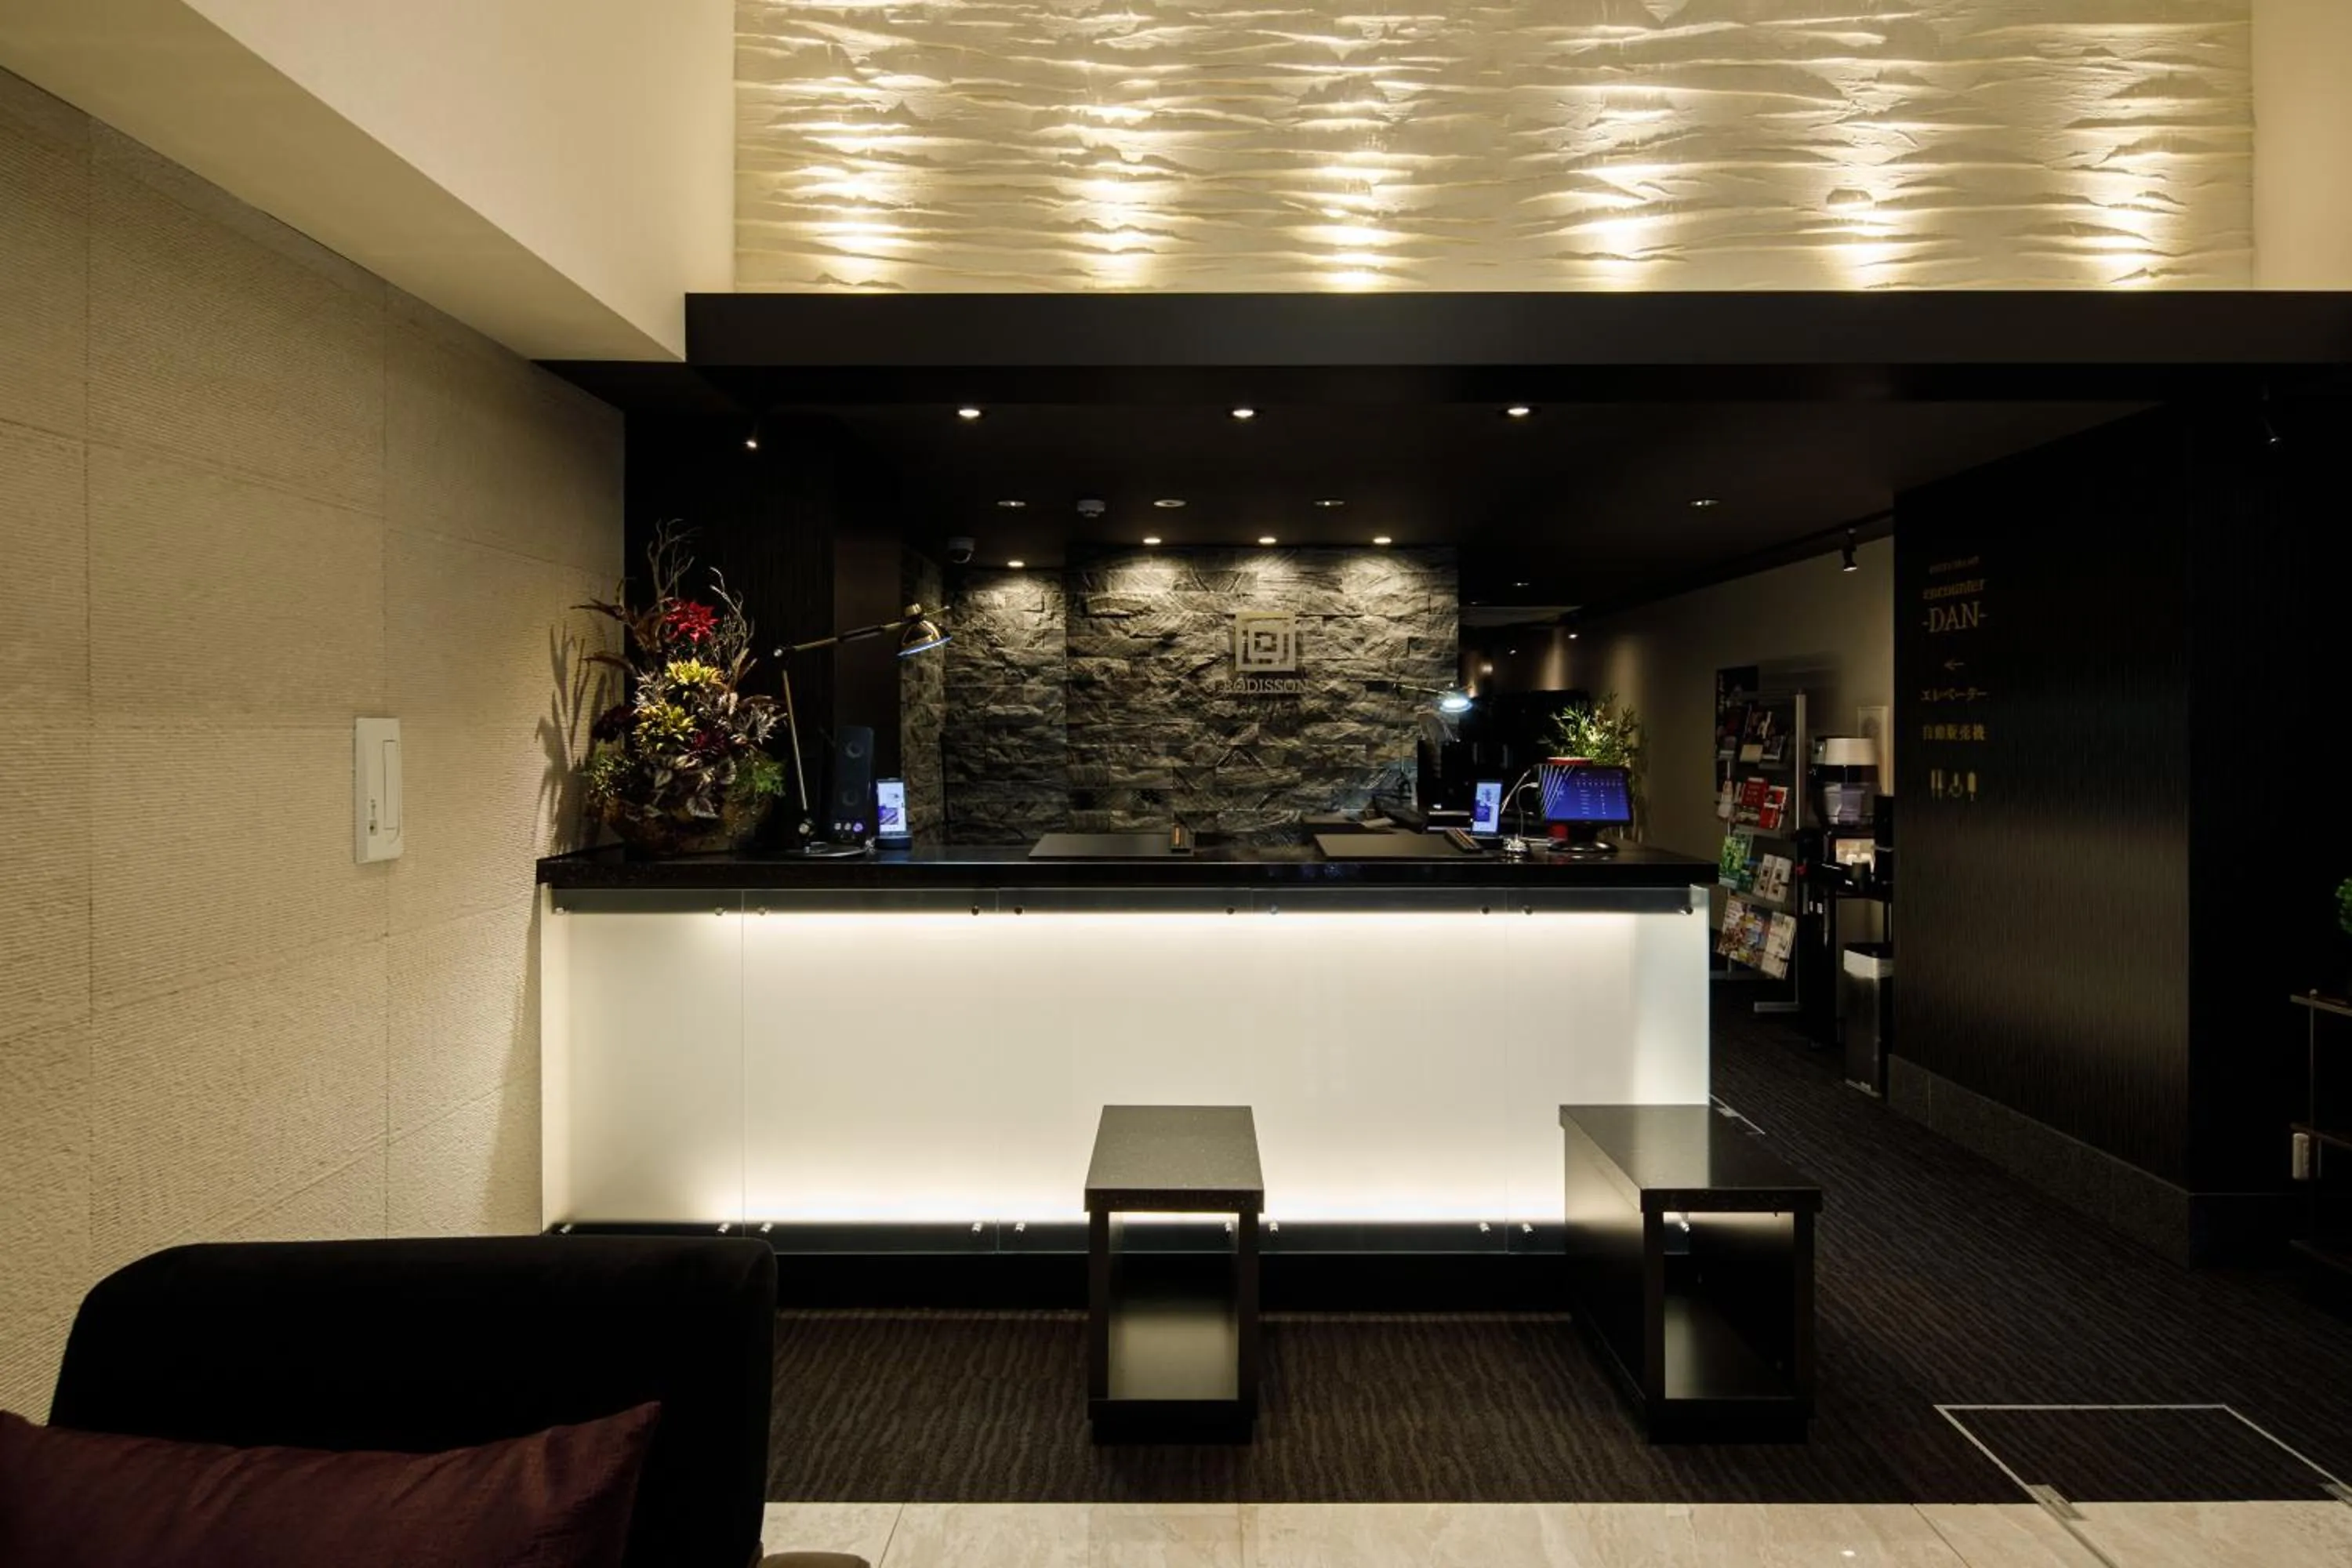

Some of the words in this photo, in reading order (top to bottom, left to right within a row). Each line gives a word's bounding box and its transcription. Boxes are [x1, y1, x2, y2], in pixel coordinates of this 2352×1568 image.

[1921, 688, 1988, 701] エレベーター
[1922, 724, 1985, 740] 自動販売機
